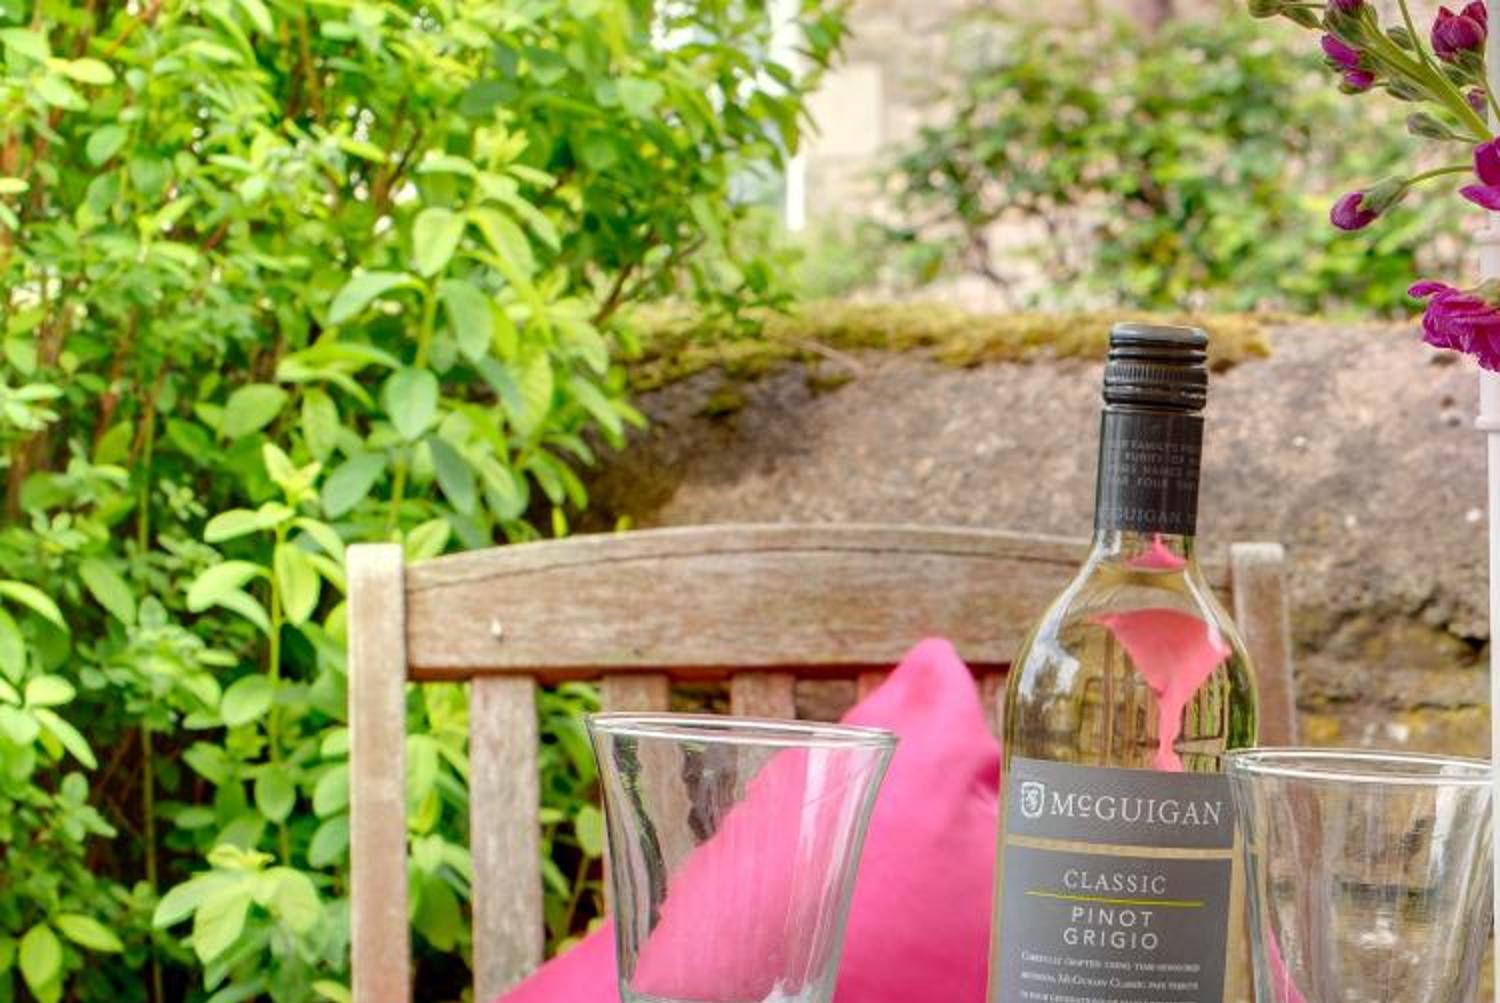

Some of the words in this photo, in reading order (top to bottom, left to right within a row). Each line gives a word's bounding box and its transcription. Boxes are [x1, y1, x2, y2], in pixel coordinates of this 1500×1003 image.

[1051, 791, 1222, 826] McGUIGAN
[1063, 869, 1167, 895] CLASSIC
[1071, 905, 1154, 927] PINOT
[1063, 927, 1159, 950] GRIGIO
